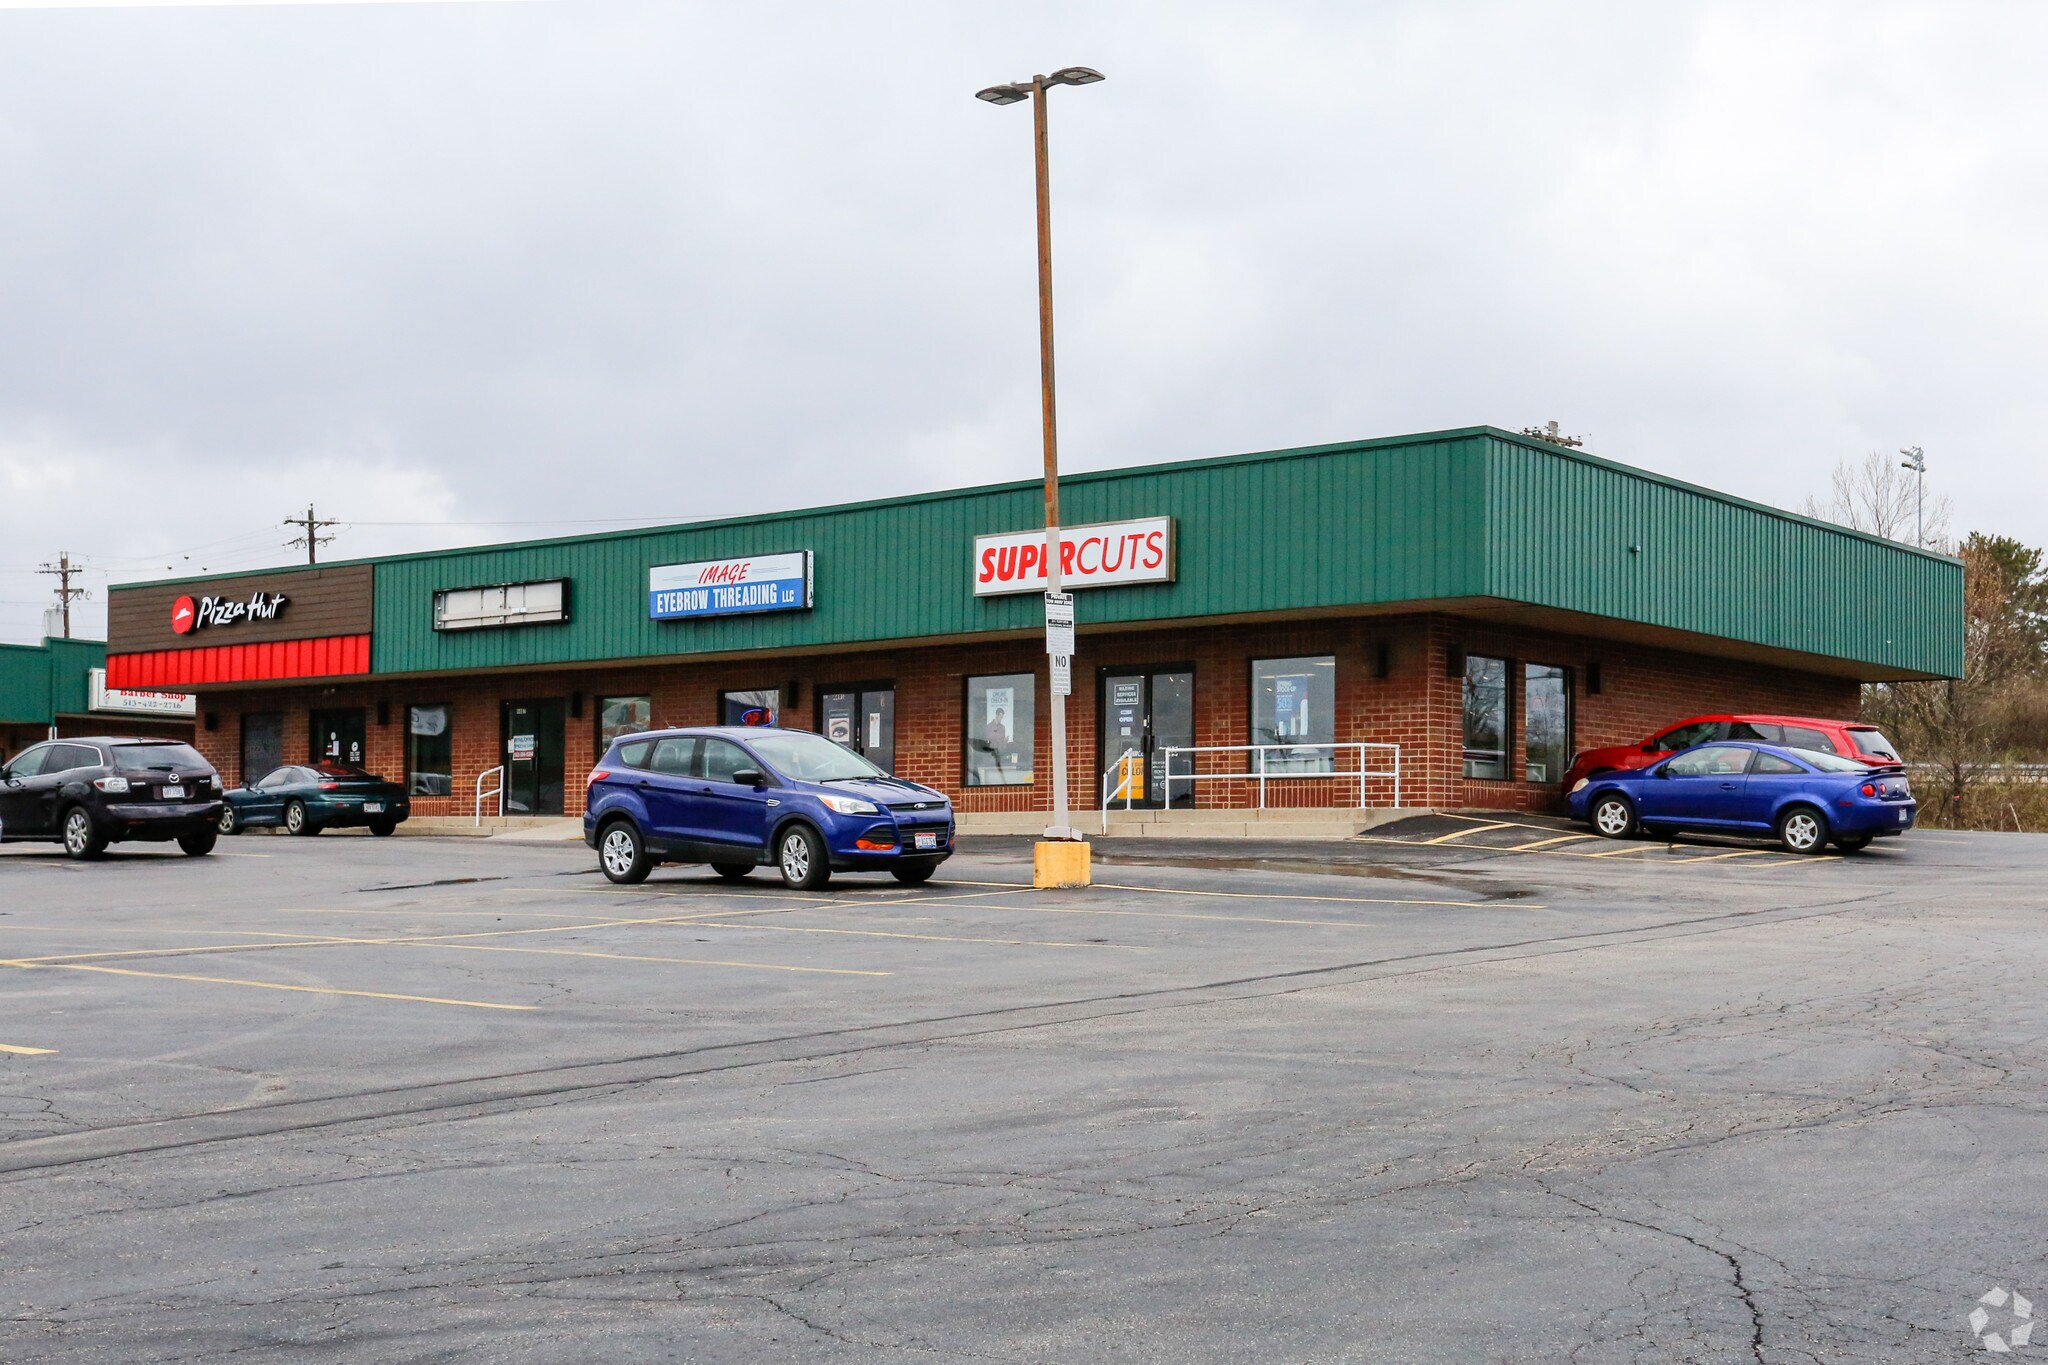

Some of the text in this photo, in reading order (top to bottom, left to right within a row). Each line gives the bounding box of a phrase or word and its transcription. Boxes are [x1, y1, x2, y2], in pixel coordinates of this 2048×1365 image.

[979, 531, 1163, 583] SUPERCUTS
[698, 562, 751, 586] IMAGE
[197, 592, 285, 629] Pizza Hut
[657, 583, 795, 613] EYEBROW THREADING LLC
[1055, 655, 1067, 668] NO
[1121, 767, 1144, 776] CLO
